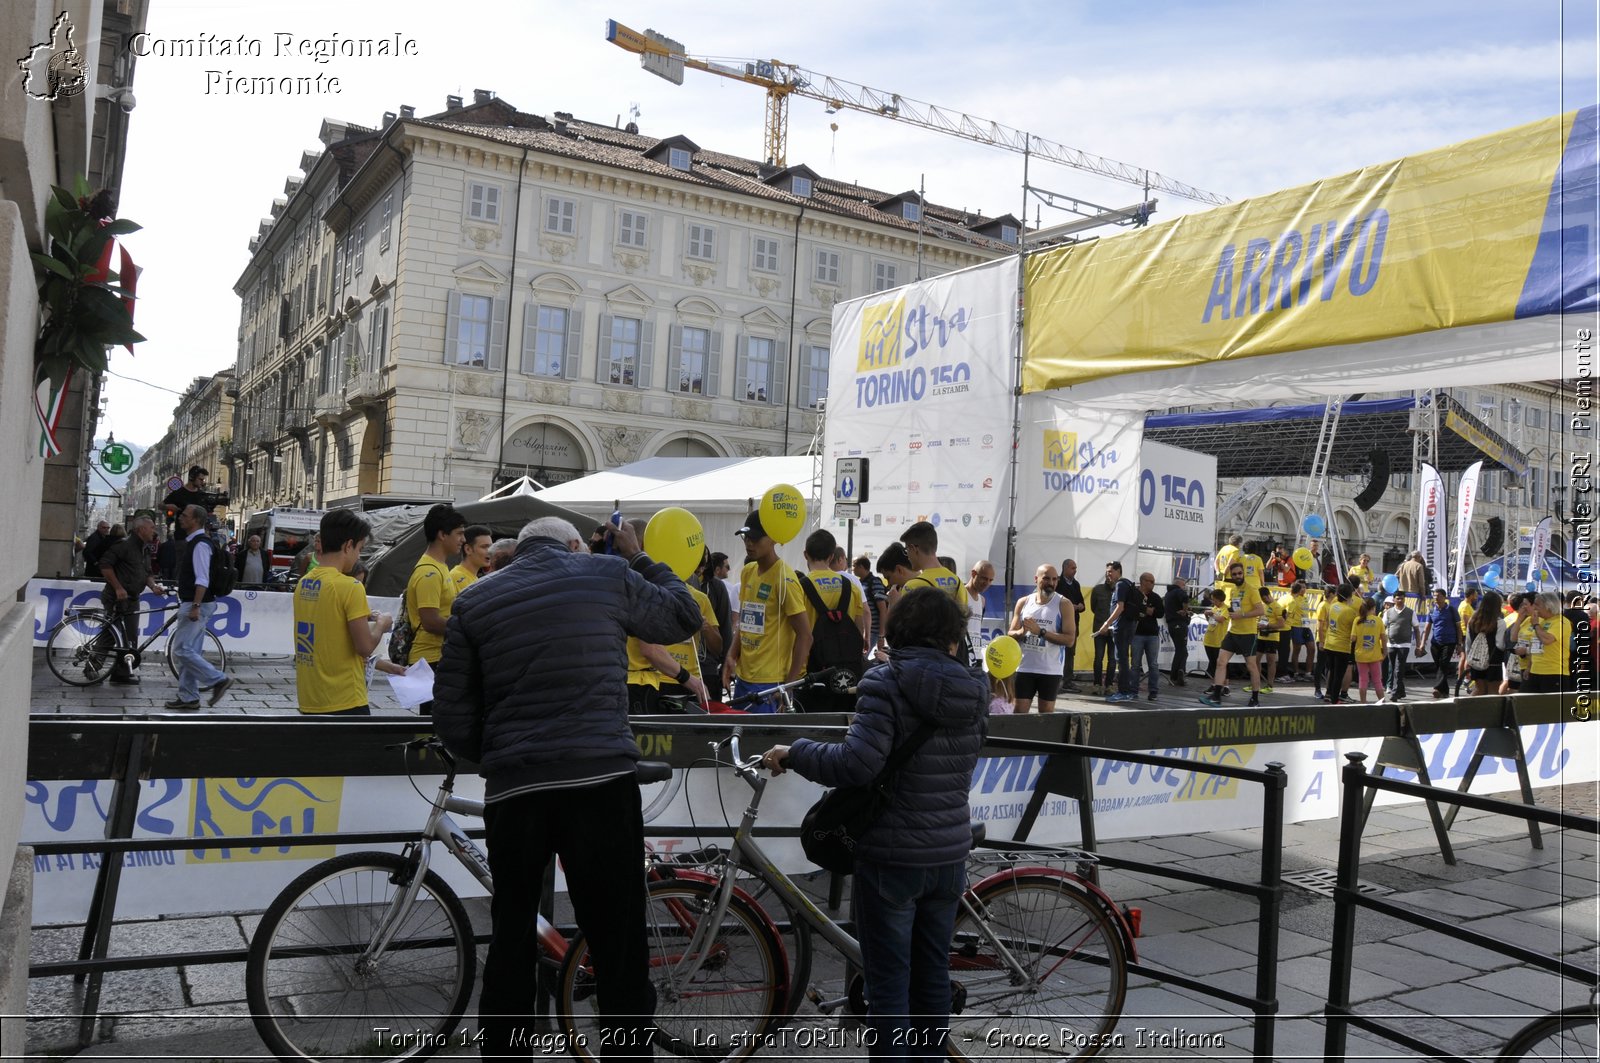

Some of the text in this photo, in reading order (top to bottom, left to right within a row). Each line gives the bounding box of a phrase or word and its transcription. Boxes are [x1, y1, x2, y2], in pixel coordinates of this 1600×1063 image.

[1201, 208, 1389, 323] ARRIVO
[905, 304, 973, 359] Stra
[856, 362, 971, 409] TORINO 150
[942, 384, 970, 394] STAMPA
[1079, 441, 1120, 469] Stra
[1043, 472, 1119, 494] TORINO 150
[1161, 474, 1205, 508] 150
[773, 503, 798, 511] TORINO
[1164, 507, 1204, 523] LA STAMPA
[1255, 521, 1280, 530] PRADA
[301, 579, 321, 591] 150
[935, 577, 957, 586] 150
[1198, 714, 1316, 740] TURIN MARATHON
